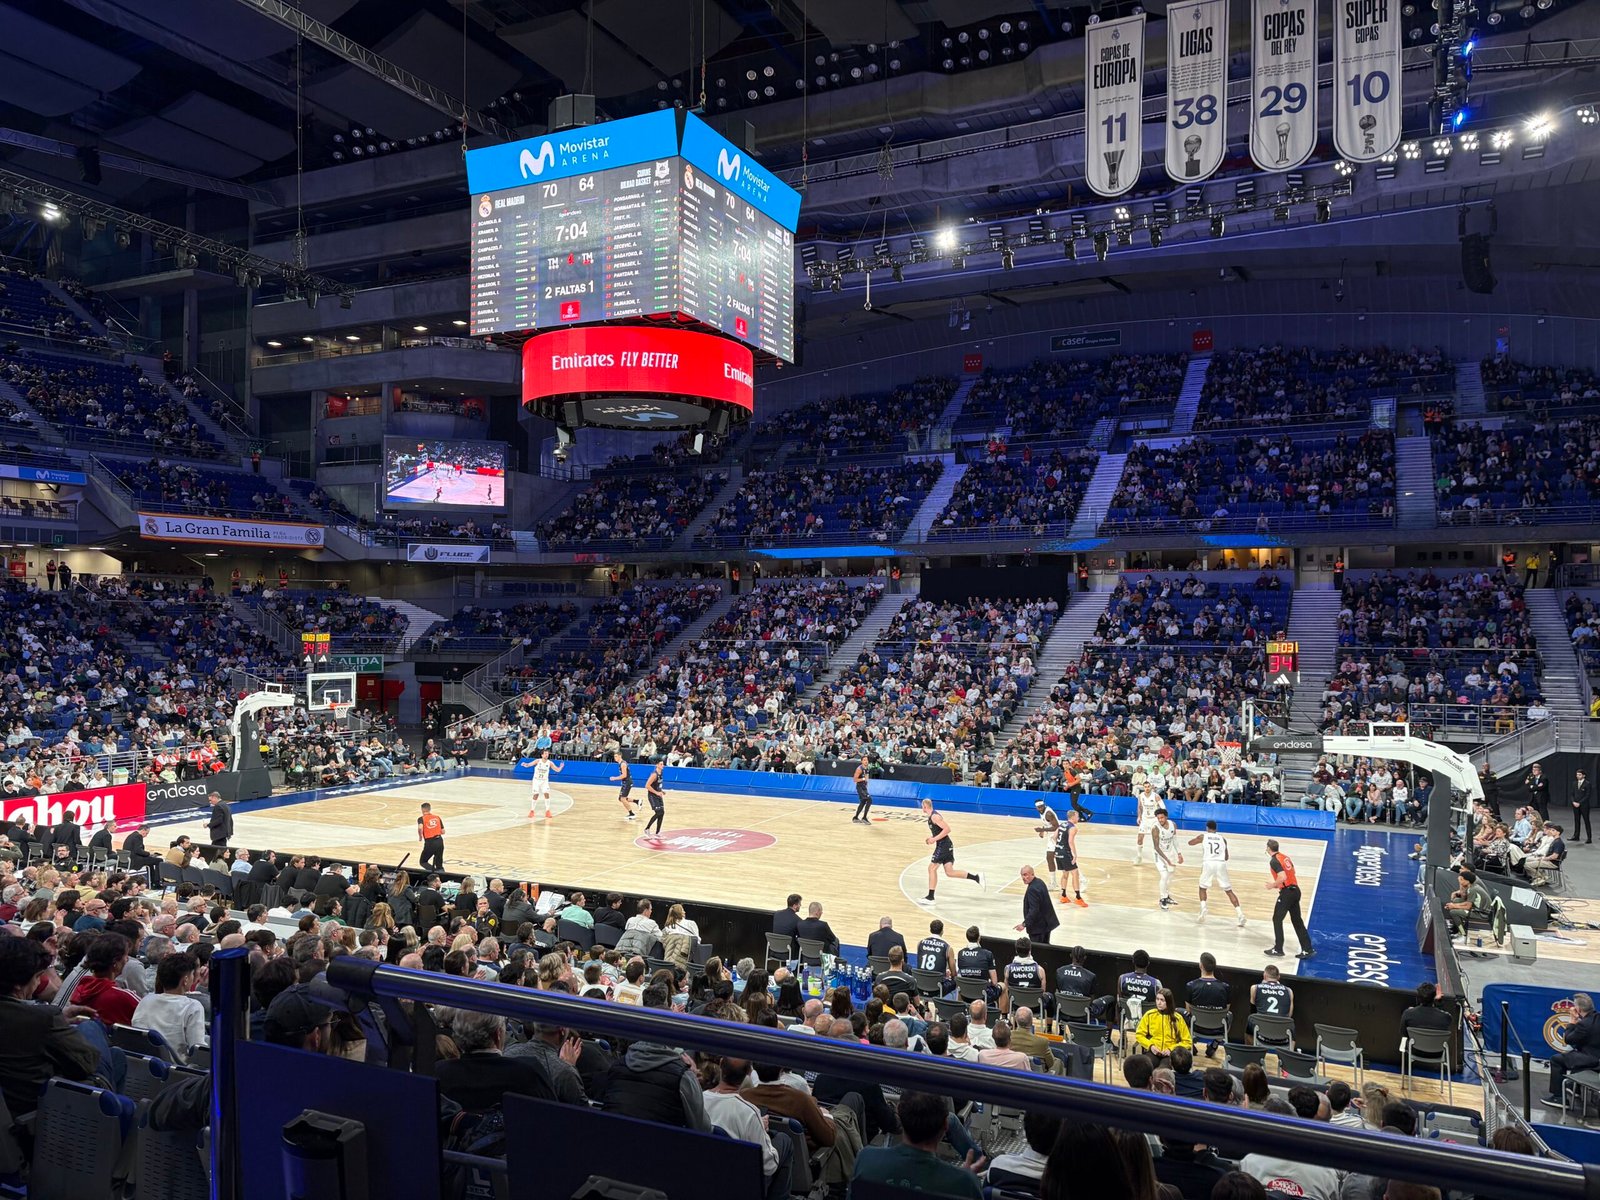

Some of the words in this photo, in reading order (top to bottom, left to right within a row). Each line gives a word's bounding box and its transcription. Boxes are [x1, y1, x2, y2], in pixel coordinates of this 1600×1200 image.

[1346, 0, 1388, 30] SUPER
[1263, 9, 1305, 41] COPAS
[1180, 26, 1213, 58] LIGAS
[1355, 26, 1379, 44] COPAS
[1100, 45, 1120, 62] COPAS
[1122, 43, 1130, 58] DE
[1271, 38, 1283, 56] DEL
[1284, 37, 1298, 54] REY
[1093, 60, 1137, 90] EUROPA
[1346, 70, 1390, 107] 10
[1259, 82, 1308, 119] 29
[1172, 94, 1218, 130] 38
[1101, 112, 1127, 145] 11
[559, 136, 610, 155] Movistar
[562, 150, 610, 167] ARENA
[542, 183, 557, 198] 70
[579, 176, 594, 191] 64
[742, 164, 770, 192] Movistar
[725, 192, 735, 209] 70
[741, 180, 768, 204] ARENA
[746, 206, 755, 222] 64
[555, 222, 588, 242] 7:04
[548, 257, 558, 266] TM
[582, 252, 593, 262] TM
[732, 240, 751, 264] 7:04
[545, 287, 552, 299] 2
[555, 283, 586, 296] FALTAS
[588, 280, 594, 293] 1
[726, 295, 732, 308] 2
[732, 298, 751, 316] FALTAS
[751, 307, 755, 318] 1
[1062, 337, 1086, 346] caser
[552, 352, 614, 371] Emirates
[620, 352, 638, 367] FLY
[640, 353, 679, 369] BETTER
[165, 522, 182, 534] La
[185, 522, 220, 536] Gran
[222, 525, 271, 539] Familia
[304, 642, 314, 654] 34
[317, 642, 329, 655] 34
[1270, 656, 1292, 672] 34
[1273, 740, 1312, 748] endesa
[146, 784, 207, 801] endesa
[0, 795, 116, 826] ahou
[1208, 842, 1220, 854] 12
[920, 954, 936, 970] 18
[1064, 969, 1082, 977] SYLLA
[1266, 996, 1279, 1013] 2
